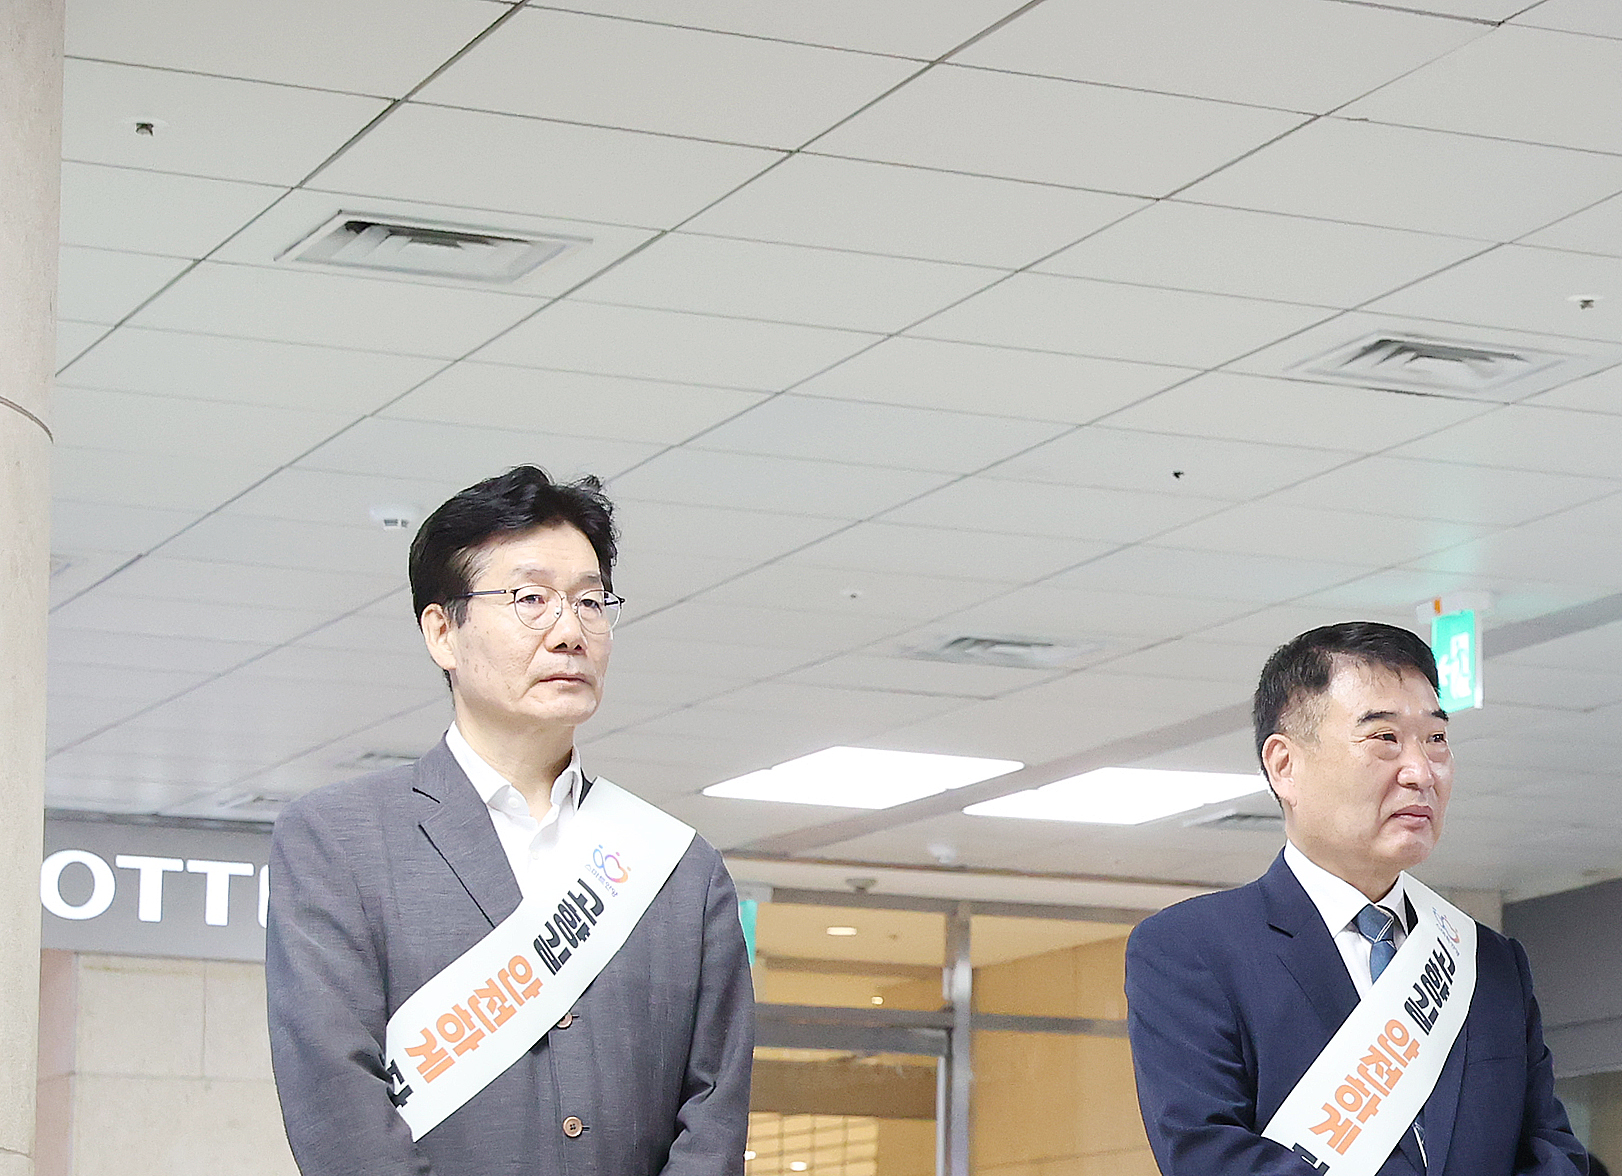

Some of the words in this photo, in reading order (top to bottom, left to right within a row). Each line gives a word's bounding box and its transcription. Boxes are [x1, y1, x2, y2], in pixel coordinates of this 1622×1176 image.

[39, 849, 270, 929] OTT
[533, 878, 605, 976] 고향길
[404, 955, 544, 1084] 안전하게
[1404, 936, 1457, 1037] 고향길
[1309, 1019, 1421, 1156] 안전하게
